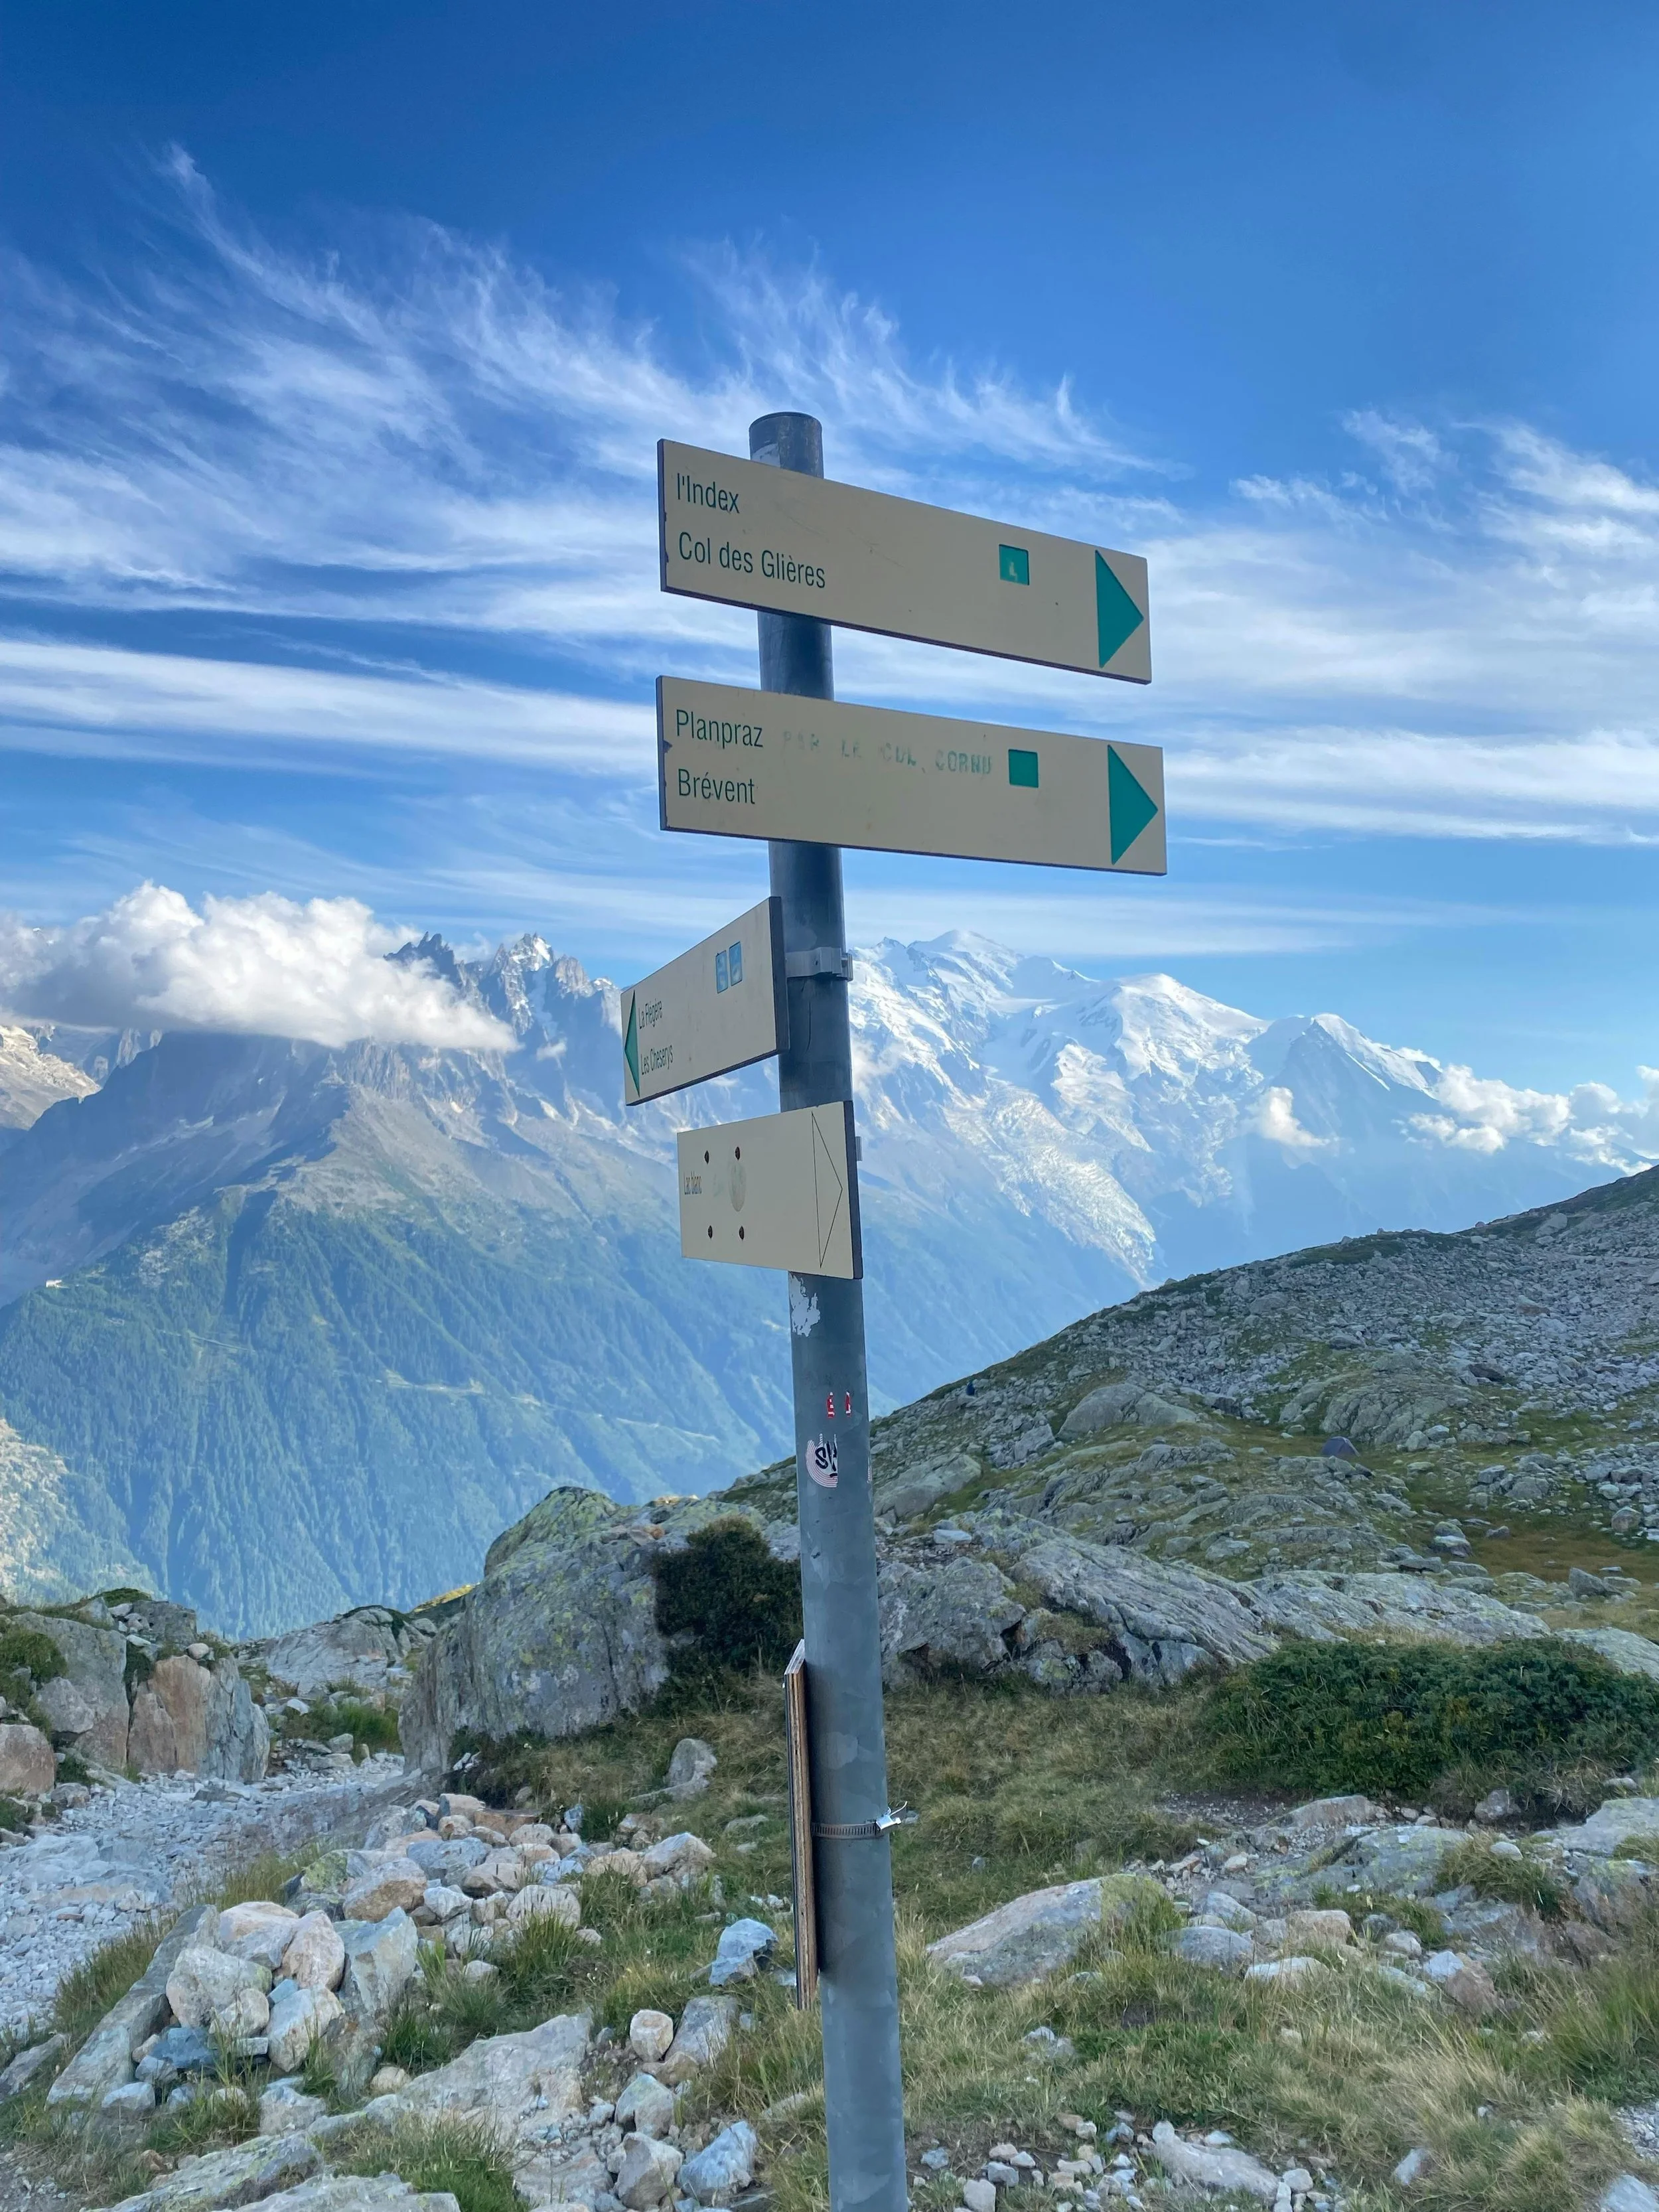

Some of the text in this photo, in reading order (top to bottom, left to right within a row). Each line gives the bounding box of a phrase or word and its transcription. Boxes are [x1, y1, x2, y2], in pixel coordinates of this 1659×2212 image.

[677, 473, 740, 514] l'Index
[679, 532, 826, 589] Col des Glières
[676, 709, 763, 749] Planpraz
[678, 769, 755, 804] Brévent
[638, 1007, 645, 1029] La
[640, 1054, 650, 1075] Les
